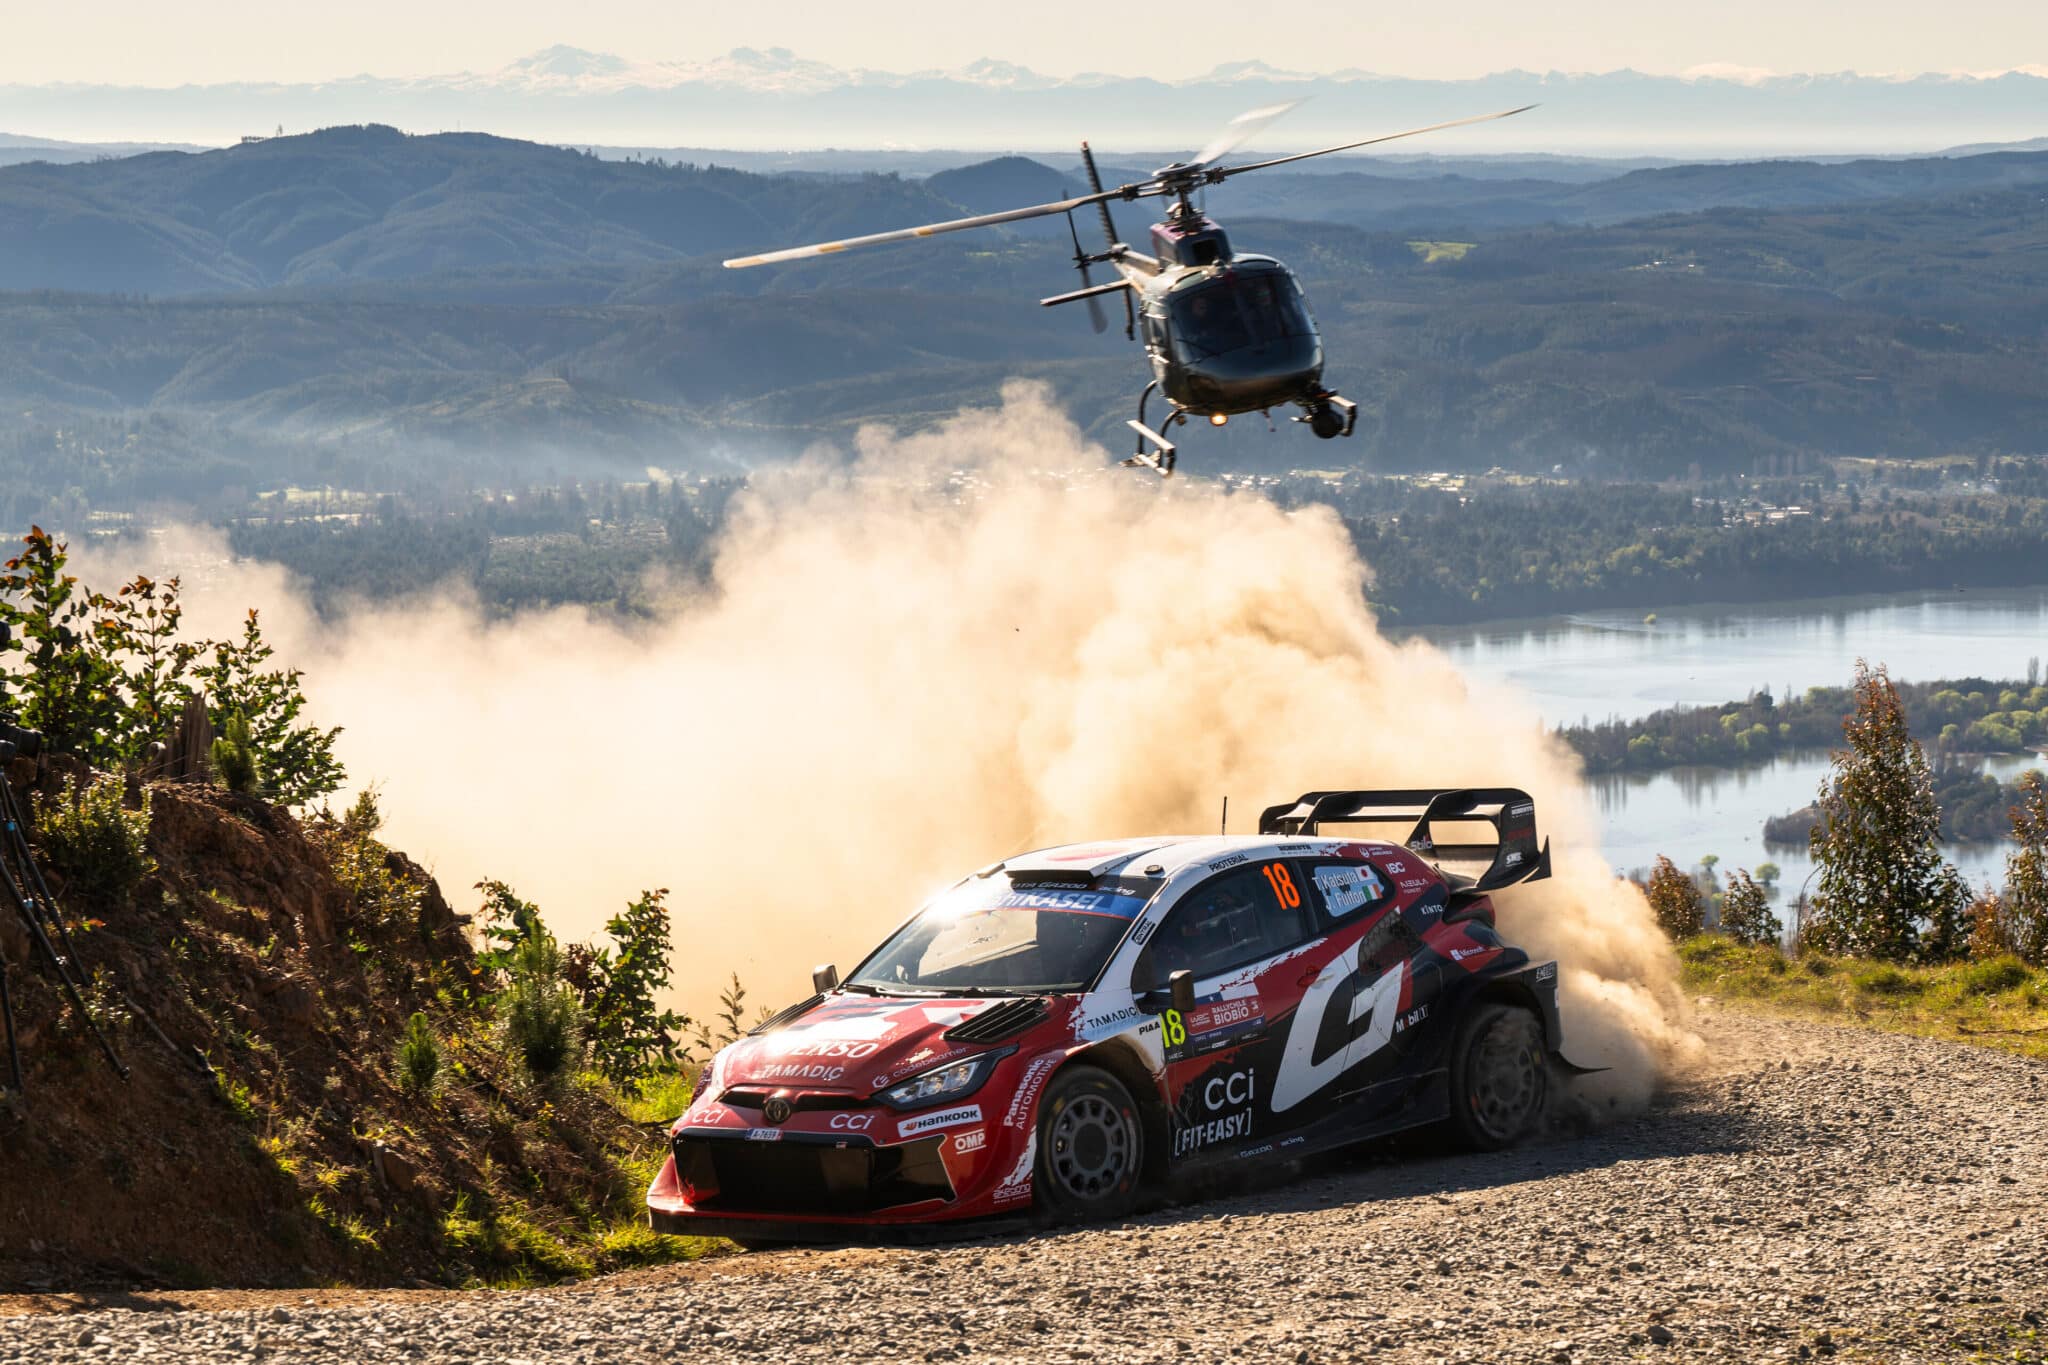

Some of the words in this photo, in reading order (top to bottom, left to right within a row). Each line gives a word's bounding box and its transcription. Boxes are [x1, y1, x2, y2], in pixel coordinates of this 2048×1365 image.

[1208, 854, 1249, 872] PROTERIAL
[1262, 863, 1300, 910] 18
[1087, 1007, 1137, 1028] TAMADIC
[1139, 1022, 1160, 1035] PIAA
[1158, 1008, 1185, 1048] 18
[759, 1064, 844, 1079] TAMADIC
[893, 1047, 968, 1078] codebeamer
[1004, 1058, 1045, 1127] Panasonic
[1016, 1058, 1057, 1130] AUTOMOTIVE
[955, 1134, 985, 1151] OMP
